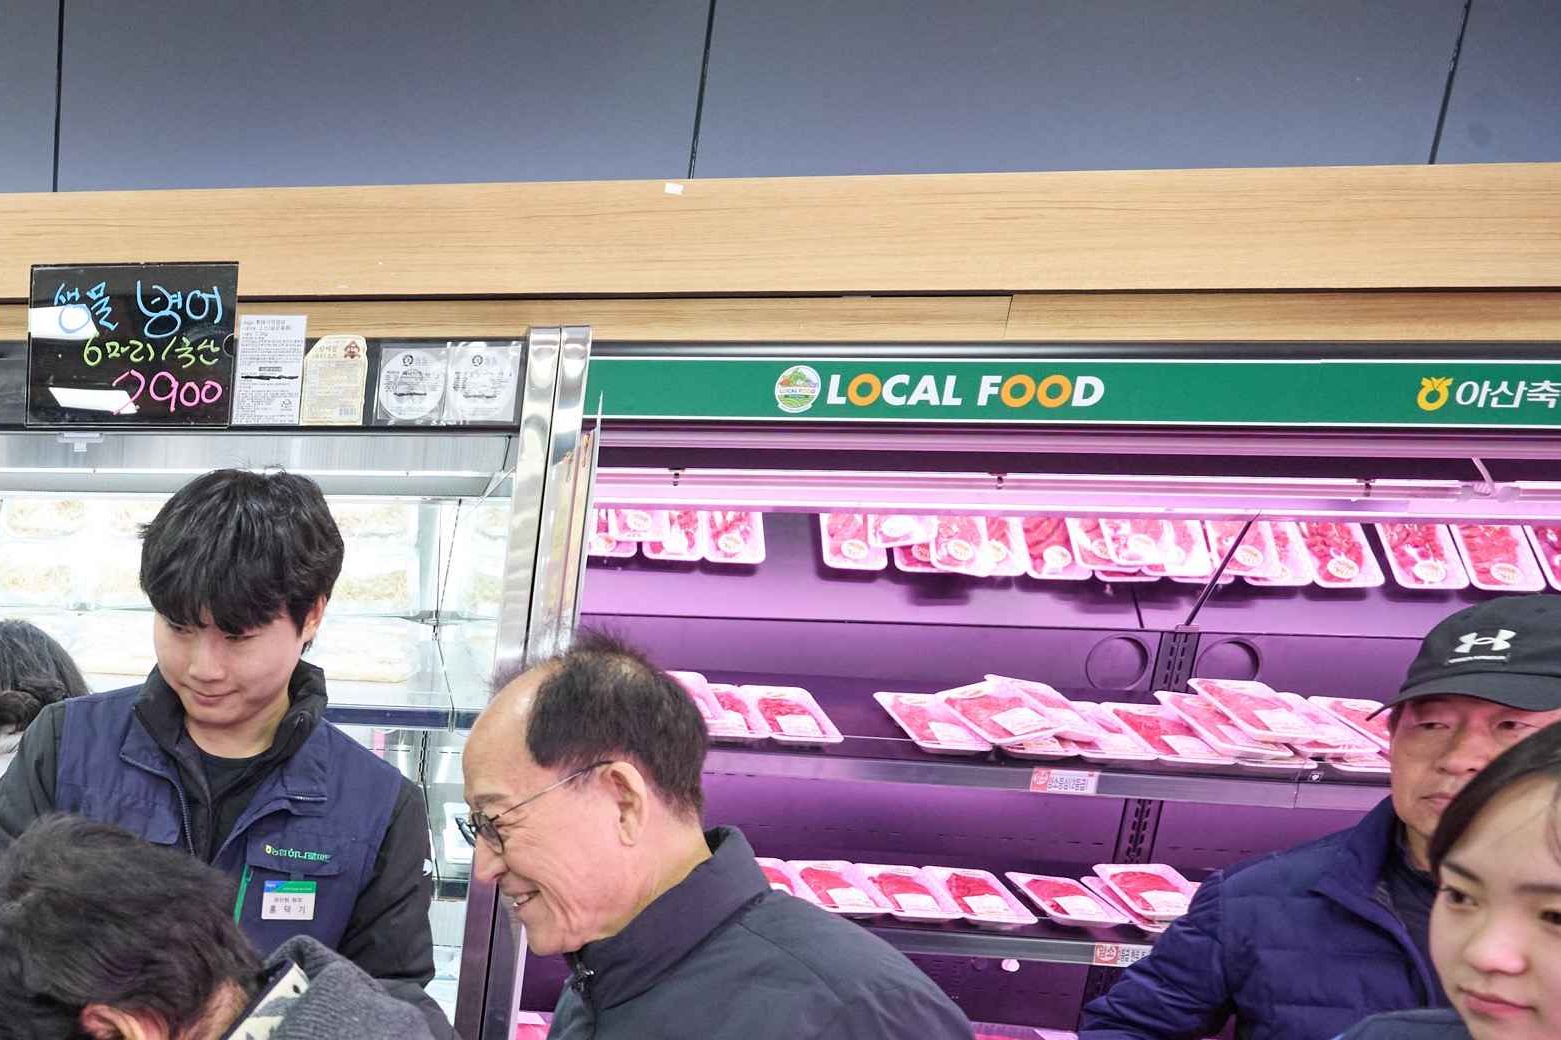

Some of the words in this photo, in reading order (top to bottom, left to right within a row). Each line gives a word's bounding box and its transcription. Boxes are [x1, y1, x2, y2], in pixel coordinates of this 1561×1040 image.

[54, 282, 119, 333] 생물
[136, 280, 223, 338] 병어
[826, 373, 963, 406] LOCAL
[977, 373, 1105, 408] FOOD
[1455, 380, 1561, 409] 아산축
